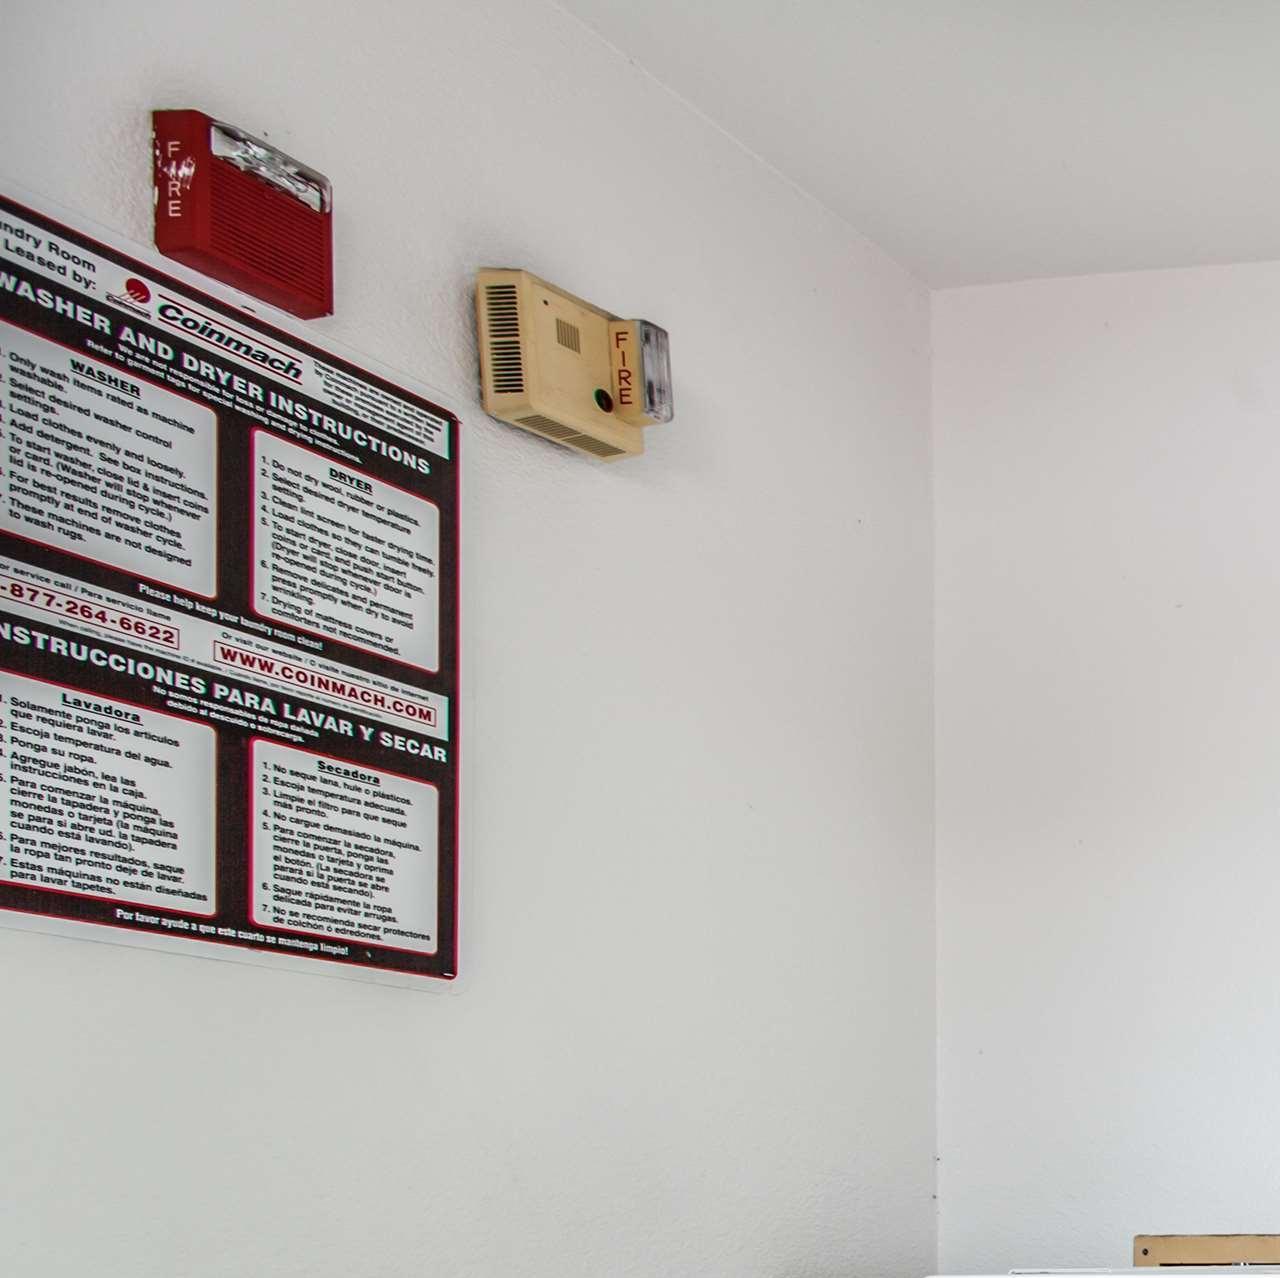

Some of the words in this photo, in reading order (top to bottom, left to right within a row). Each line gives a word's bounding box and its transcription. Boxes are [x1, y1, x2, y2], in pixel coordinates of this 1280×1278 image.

[0, 221, 41, 249] ndry
[48, 241, 95, 272] Room
[4, 238, 66, 276] Leased
[72, 270, 96, 289] by:
[158, 304, 302, 379] Coinmach
[9, 364, 63, 391] washable.
[70, 359, 140, 396] WASHER
[616, 332, 632, 405] FIRE
[8, 351, 36, 371] Only
[39, 366, 70, 383] wash
[73, 378, 103, 396] items
[106, 392, 133, 409] rated
[136, 405, 149, 415] as
[151, 411, 195, 434] machine
[9, 390, 58, 415] settings.
[9, 377, 45, 398] Select
[48, 395, 90, 416] desired
[93, 412, 132, 432] washer
[135, 429, 171, 448] control
[119, 326, 173, 360] AND
[183, 352, 263, 401] DRYER
[270, 391, 429, 473] INSTRUCTIONS
[9, 403, 38, 421] Load
[41, 417, 83, 438] clothes
[85, 435, 121, 454] evenly
[124, 449, 144, 462] and
[146, 456, 185, 478] loosely.
[271, 459, 285, 471] Do
[286, 467, 302, 478] not
[304, 474, 319, 486] dry
[346, 491, 374, 506] rubber
[329, 467, 372, 492] DRYER
[62, 692, 140, 722] Lavadora
[220, 646, 431, 721] WWW.COINMACH.COM
[10, 696, 72, 720] Solamente
[75, 715, 110, 730] ponga
[114, 723, 130, 734] los
[214, 683, 276, 714] PARA
[283, 703, 353, 736] LAVAR
[359, 724, 374, 741] Y
[379, 731, 446, 762] SECAR
[10, 721, 50, 739] Escoja
[53, 732, 121, 756] temperatura
[124, 750, 141, 760] del
[143, 755, 172, 768] agua.
[10, 735, 47, 753] Ponga
[50, 747, 65, 756] su
[68, 751, 96, 764] ropa.
[273, 763, 287, 774] No
[289, 769, 317, 781] seque
[343, 782, 362, 792] hule
[317, 760, 379, 784] Secadora
